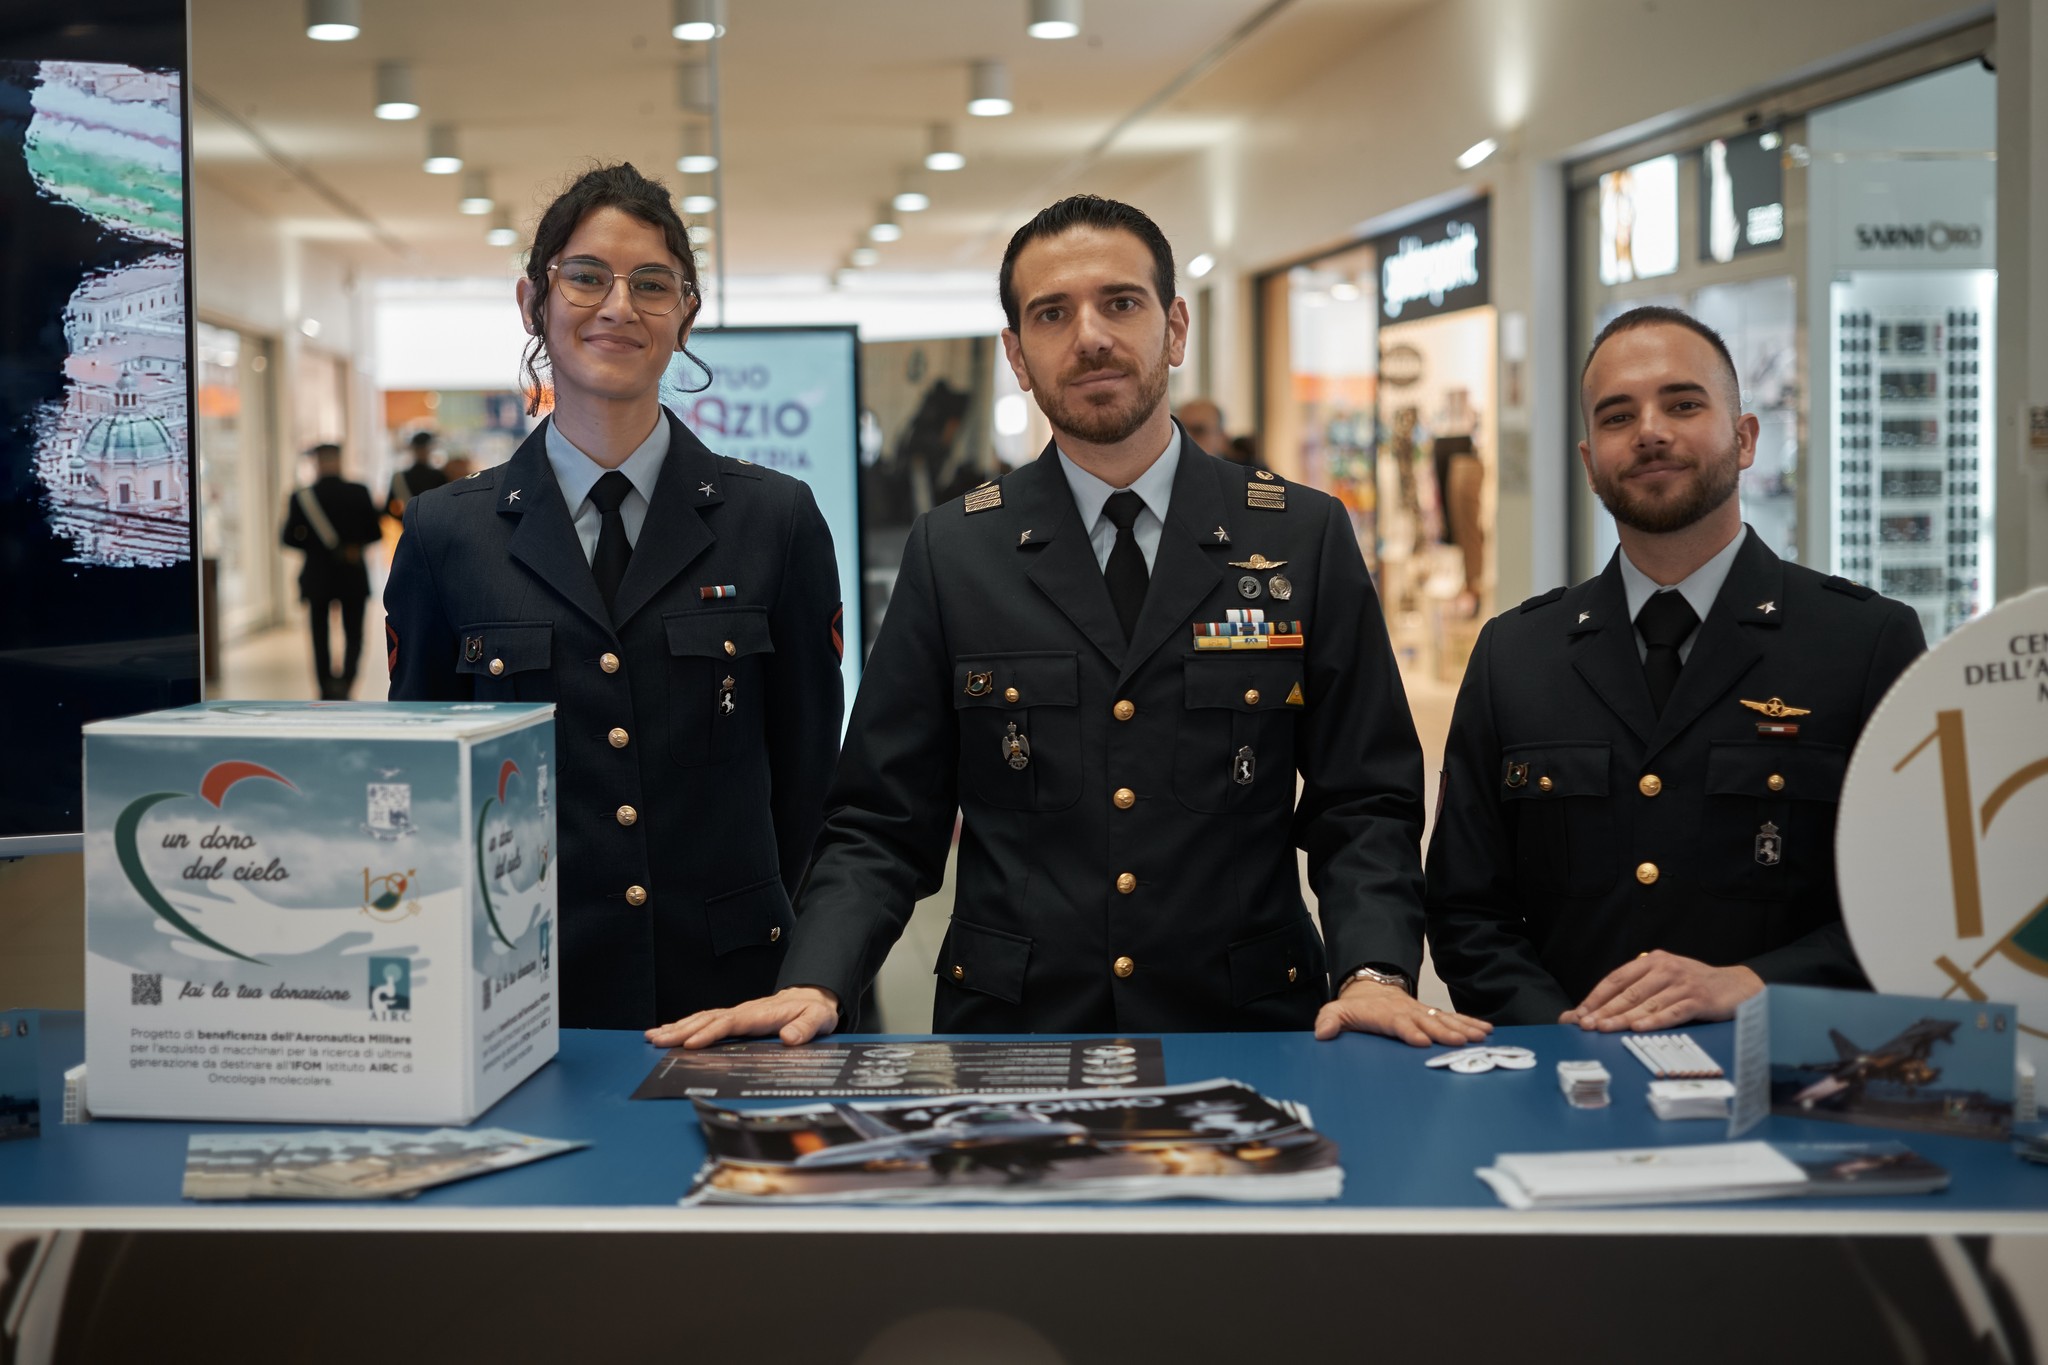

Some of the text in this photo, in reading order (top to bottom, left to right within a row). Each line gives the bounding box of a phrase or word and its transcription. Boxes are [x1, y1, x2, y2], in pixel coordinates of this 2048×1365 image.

[2009, 633, 2048, 656] CE
[162, 825, 257, 850] un dono
[182, 856, 290, 882] dal cielo
[179, 981, 351, 1001] fai la tua donazione
[369, 1010, 412, 1022] AIRC
[130, 1028, 412, 1044] Progetto di beneficenza dell'Aeronautica Militare
[130, 1043, 412, 1060] per l'acquisto di macchinari per la ricerca di ultima
[130, 1059, 199, 1069] generazione
[202, 1059, 217, 1069] da
[220, 1060, 272, 1070] destinare
[369, 1063, 398, 1073] AIRC
[402, 1063, 412, 1074] di
[208, 1072, 266, 1085] Oncologia
